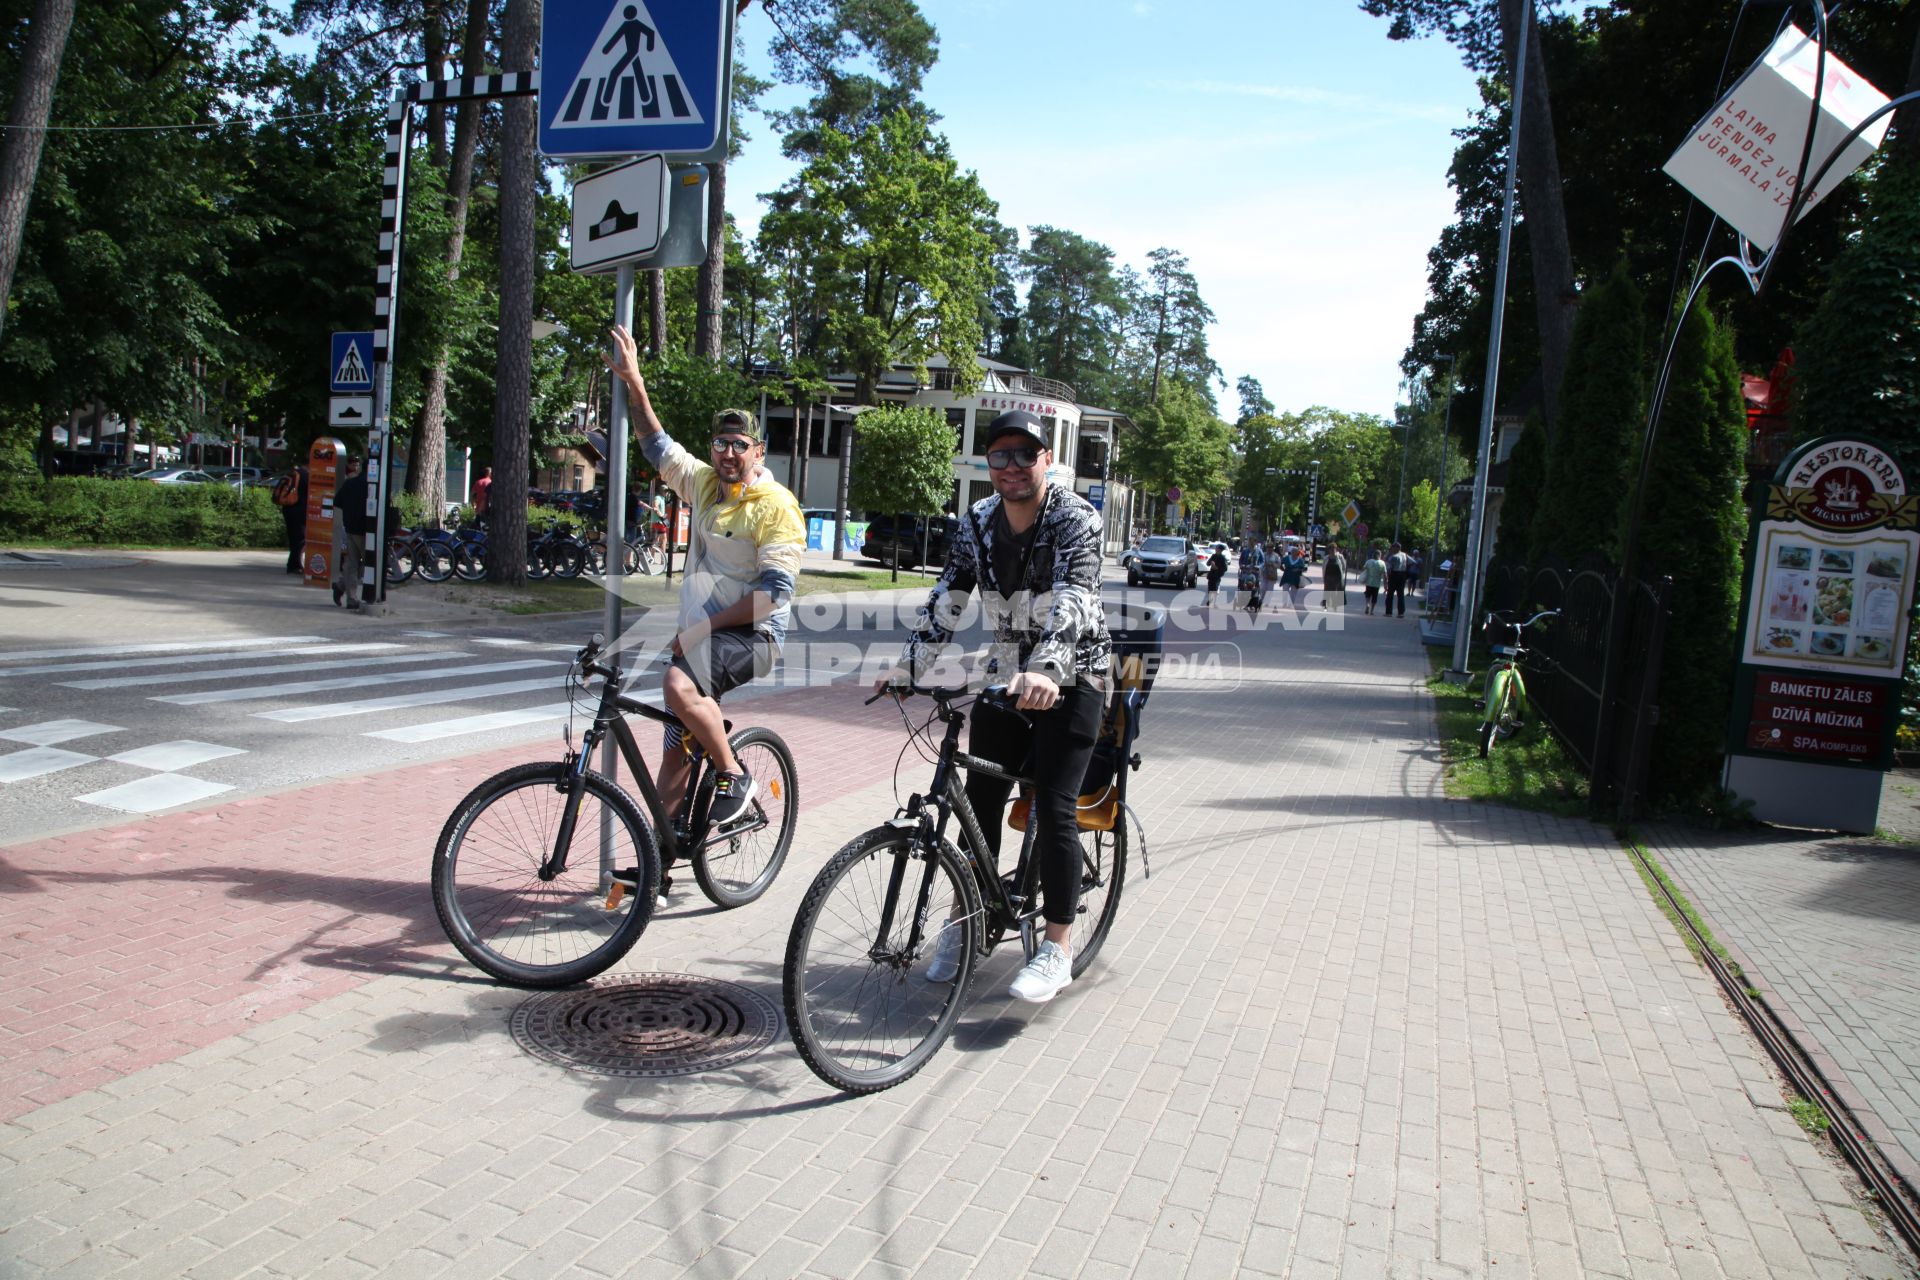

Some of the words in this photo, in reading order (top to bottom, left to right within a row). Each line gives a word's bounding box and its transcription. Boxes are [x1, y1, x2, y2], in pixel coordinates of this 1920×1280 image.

[1725, 100, 1777, 145] LAIMA
[1711, 116, 1775, 168] RENDEZ
[1775, 166, 1818, 203] VOS
[1793, 446, 1900, 490] RESTORĀNS
[1812, 506, 1846, 522] PEGASA
[1850, 511, 1872, 522] PILS
[1770, 681, 1830, 699] BANKETU
[1833, 686, 1873, 703] ZĀLES
[1772, 706, 1811, 723] DZĪVĀ
[1814, 711, 1863, 728] MŪZIKA
[1793, 736, 1818, 749] SPA
